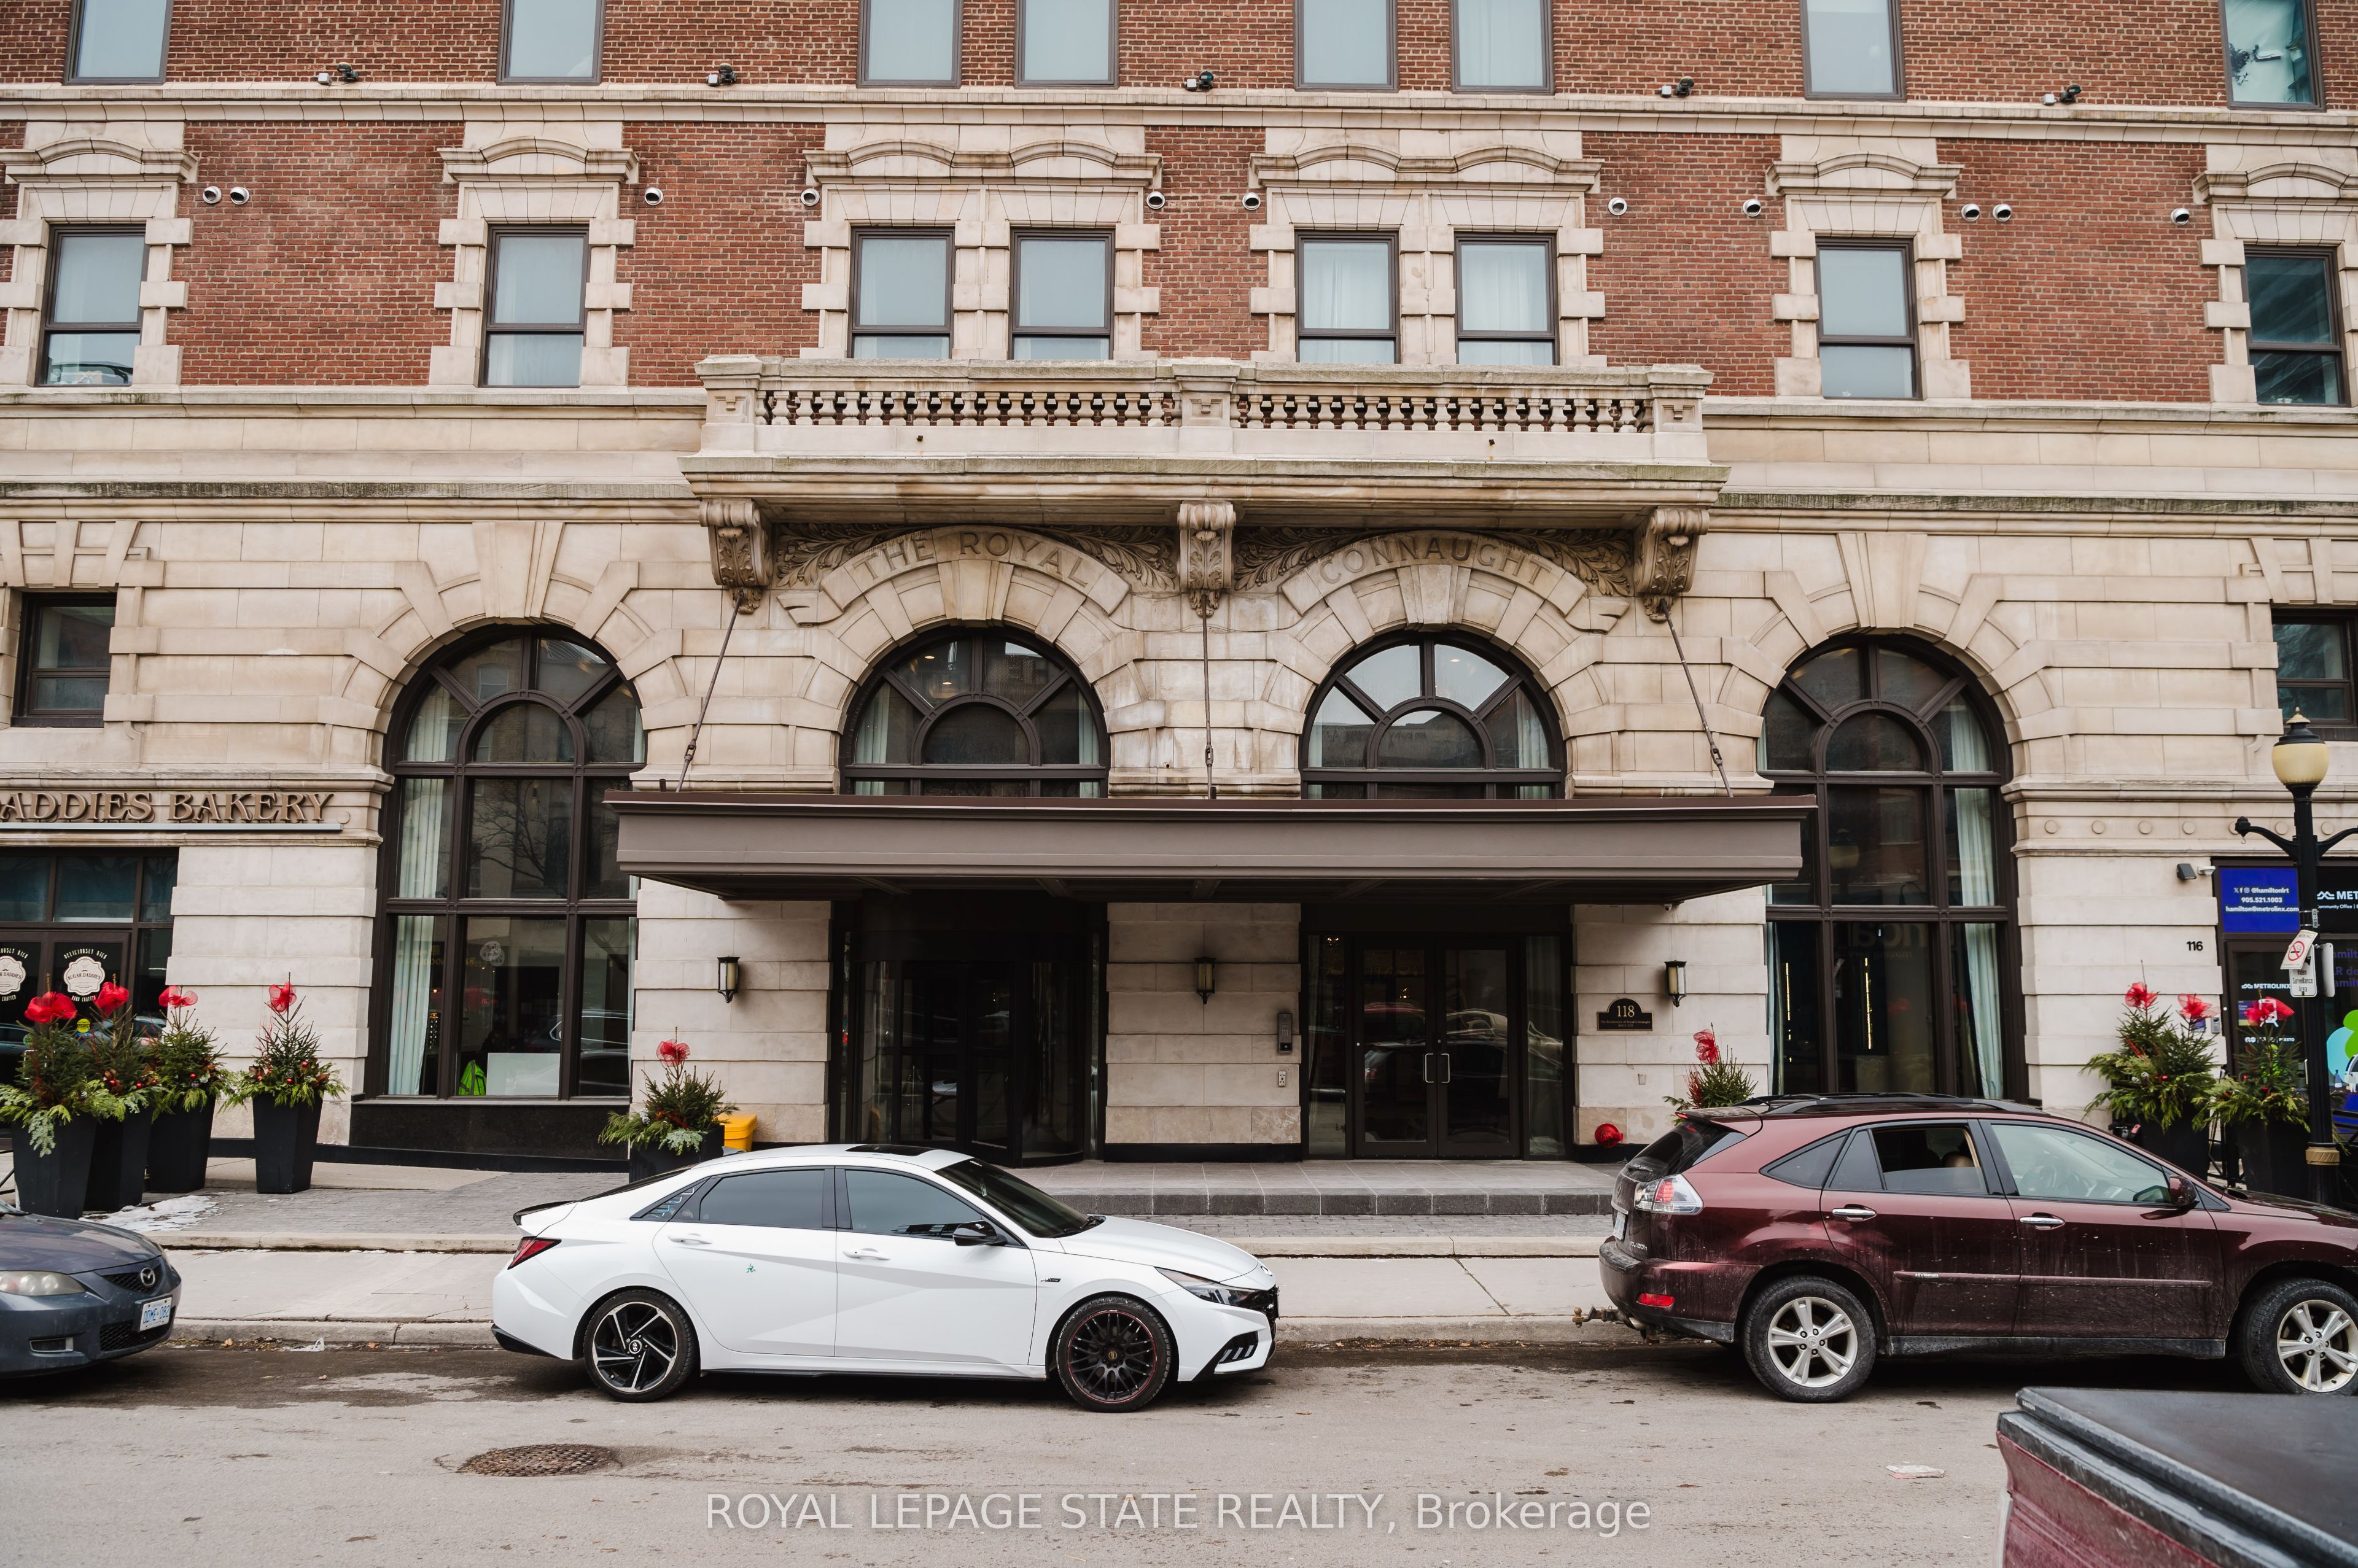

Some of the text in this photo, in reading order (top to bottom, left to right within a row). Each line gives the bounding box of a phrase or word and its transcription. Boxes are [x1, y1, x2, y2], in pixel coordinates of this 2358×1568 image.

[853, 530, 1093, 588] THE ROYAL
[1318, 536, 1553, 588] CONNAUGHT
[0, 792, 334, 821] ADDIES BAKERY
[2186, 941, 2203, 952] 116
[1617, 1005, 1635, 1017] 118
